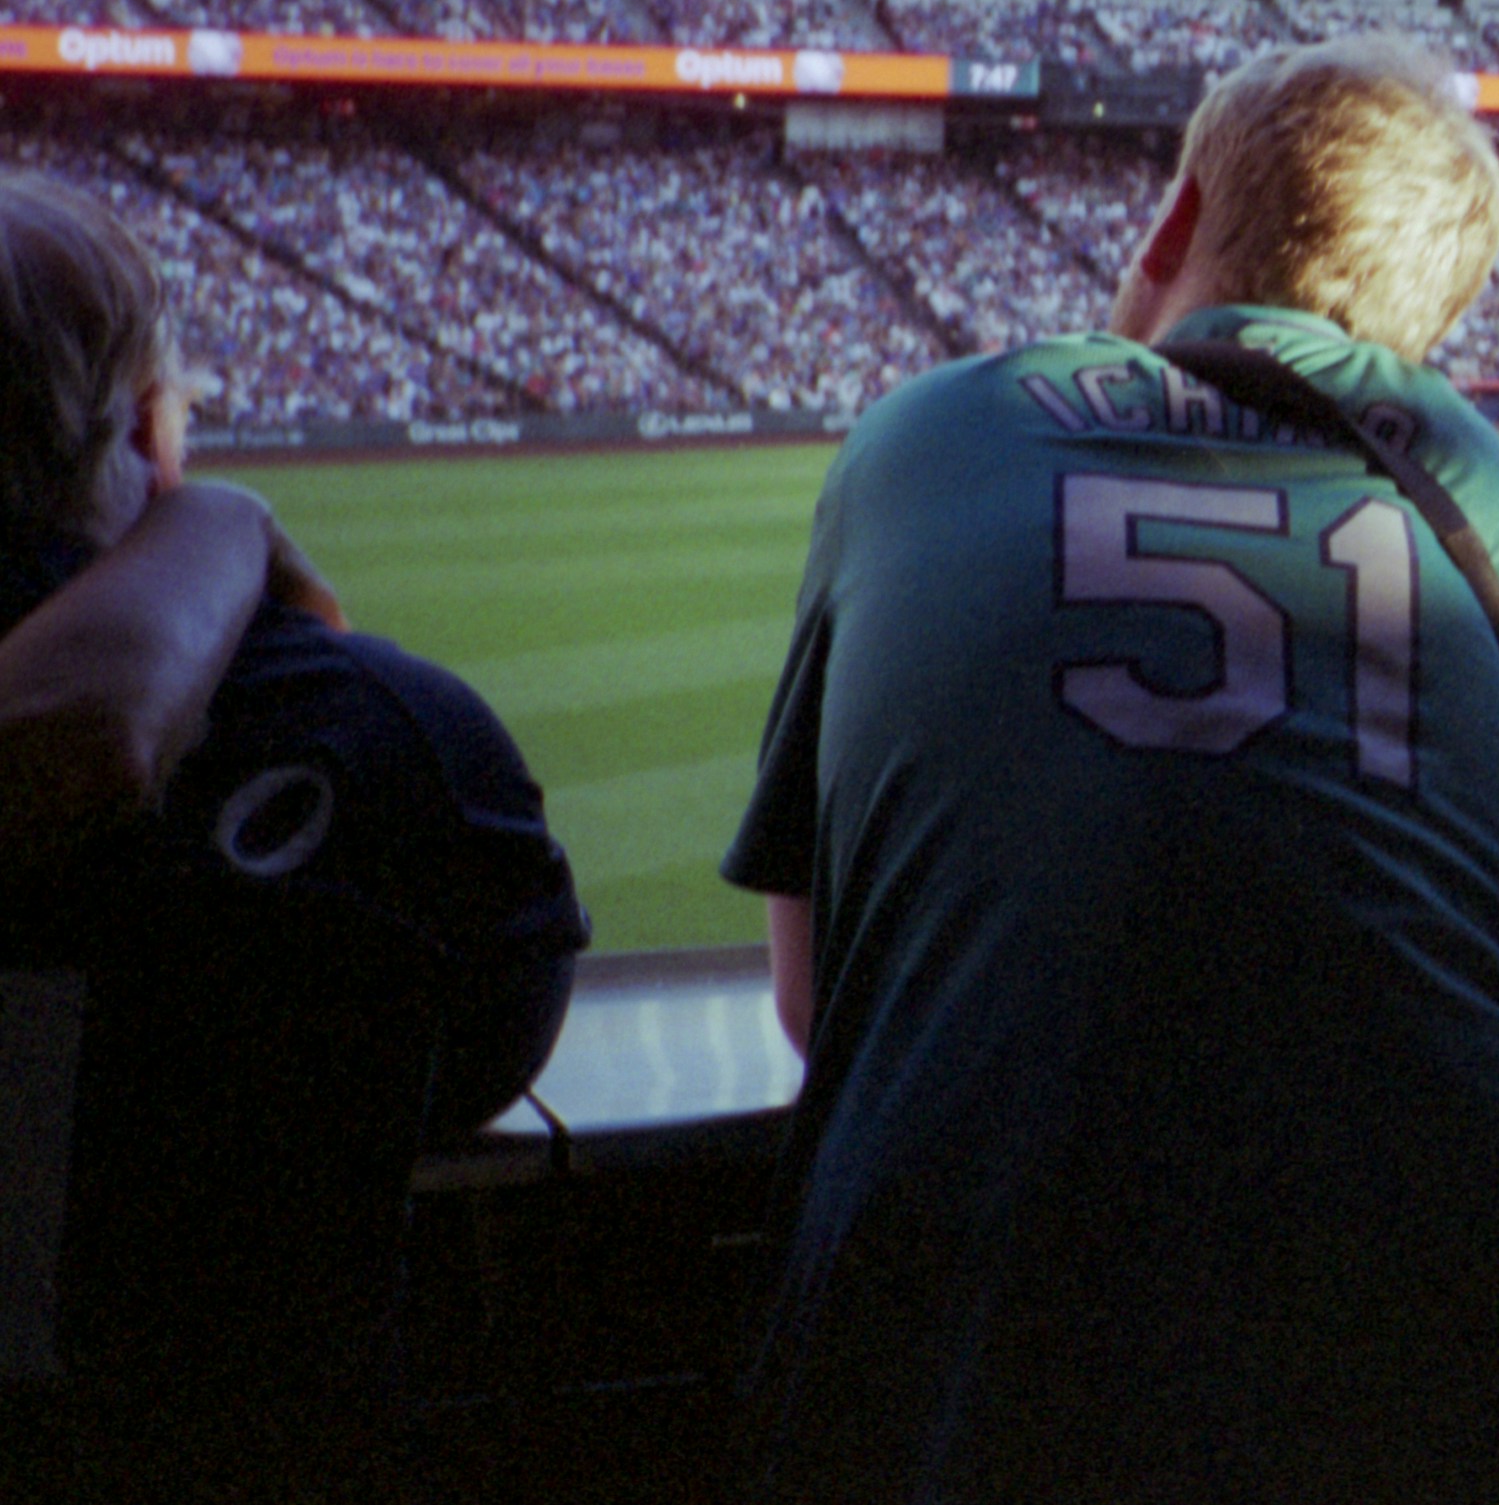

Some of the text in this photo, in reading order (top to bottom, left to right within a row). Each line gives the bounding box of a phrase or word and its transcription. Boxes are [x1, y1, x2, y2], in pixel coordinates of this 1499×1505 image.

[57, 26, 176, 72] Optum
[675, 49, 784, 90] Optum
[1056, 472, 1418, 790] 51
